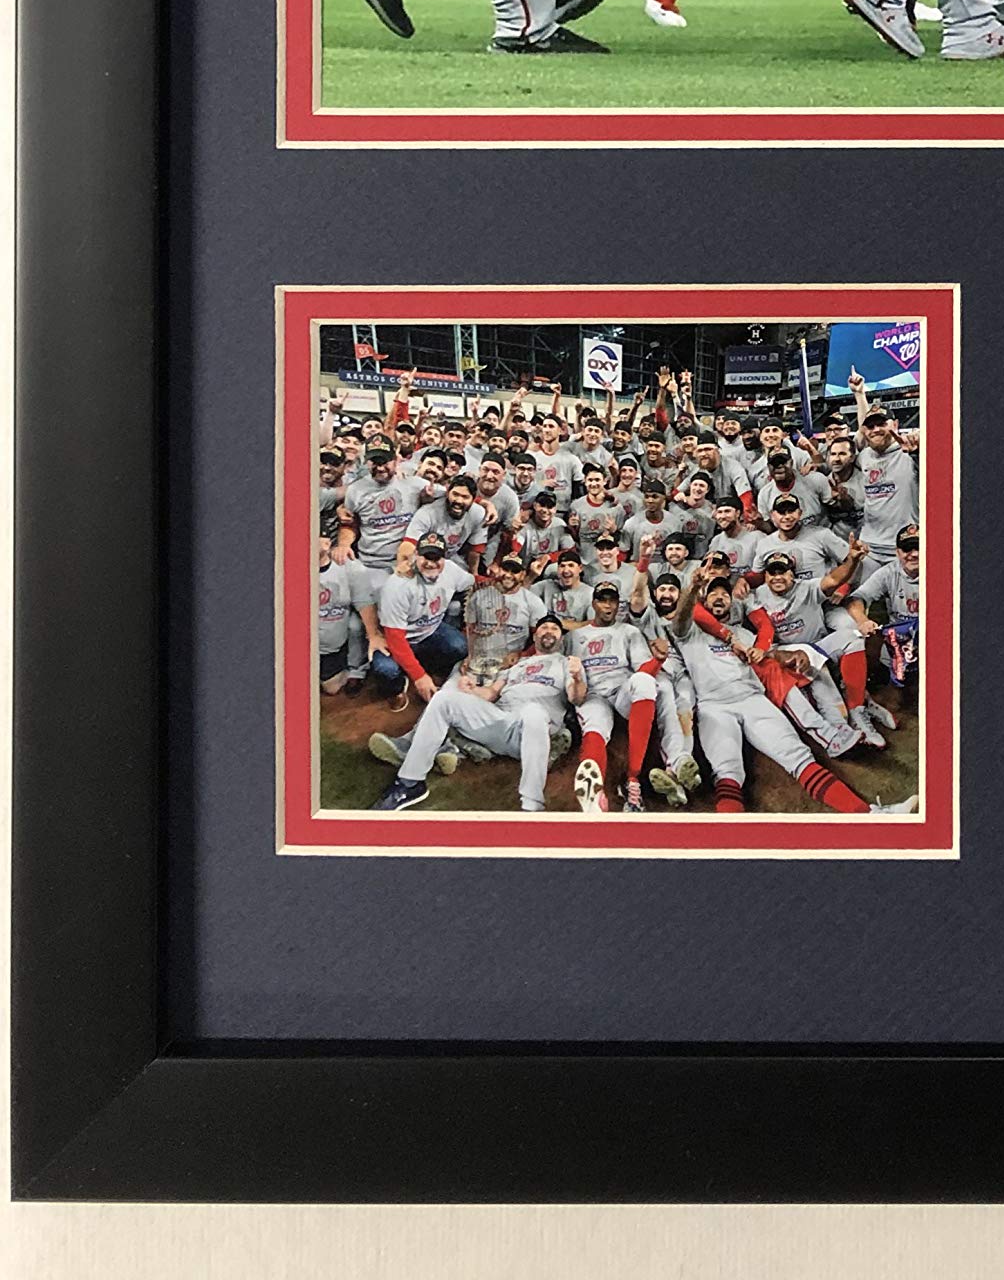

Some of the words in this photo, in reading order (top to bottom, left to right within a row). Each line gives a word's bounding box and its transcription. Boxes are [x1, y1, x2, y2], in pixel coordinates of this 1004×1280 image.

[873, 330, 920, 349] CHAMP
[587, 358, 619, 372] OXY
[346, 372, 386, 382] ASTROS
